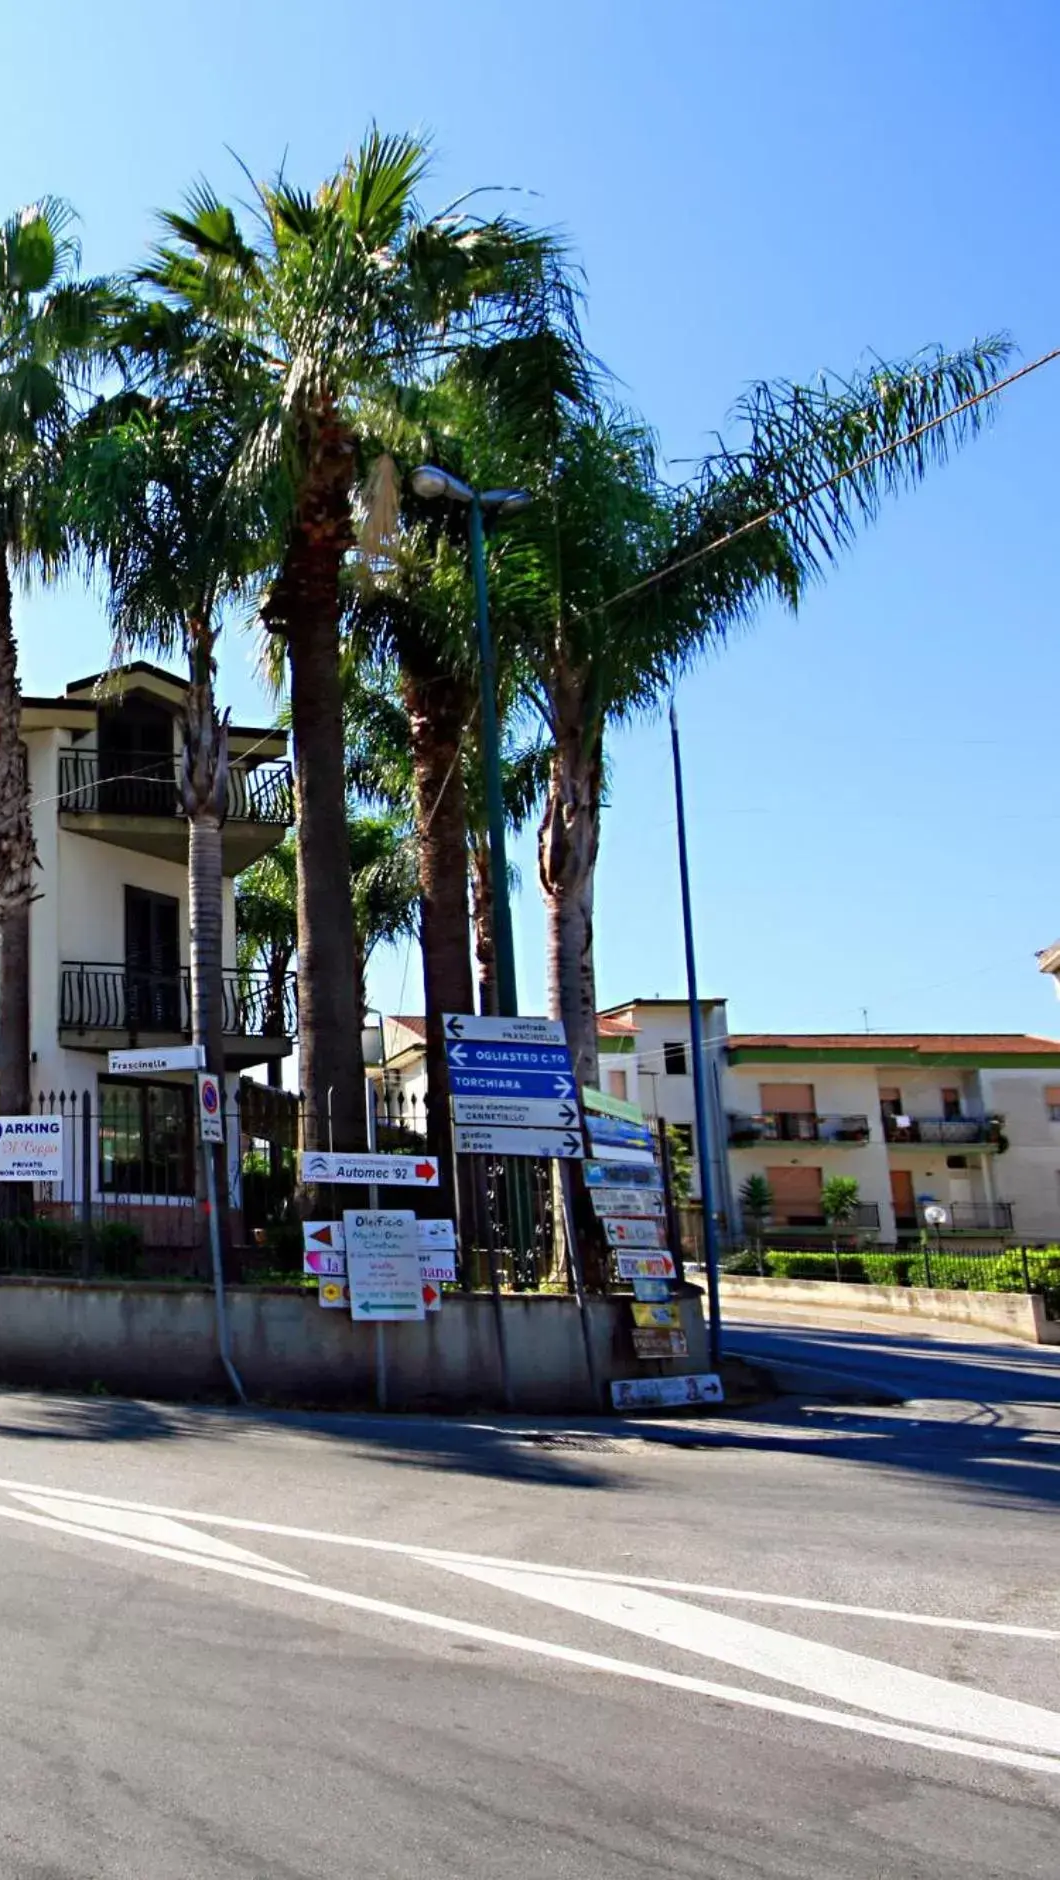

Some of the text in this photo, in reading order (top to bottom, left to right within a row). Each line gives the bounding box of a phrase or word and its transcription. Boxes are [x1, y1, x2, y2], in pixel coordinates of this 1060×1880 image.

[475, 1051, 538, 1062] OGLIASTRO
[454, 1076, 522, 1089] TORCHIARA
[336, 1166, 389, 1179] Automec
[393, 1167, 408, 1179] '92
